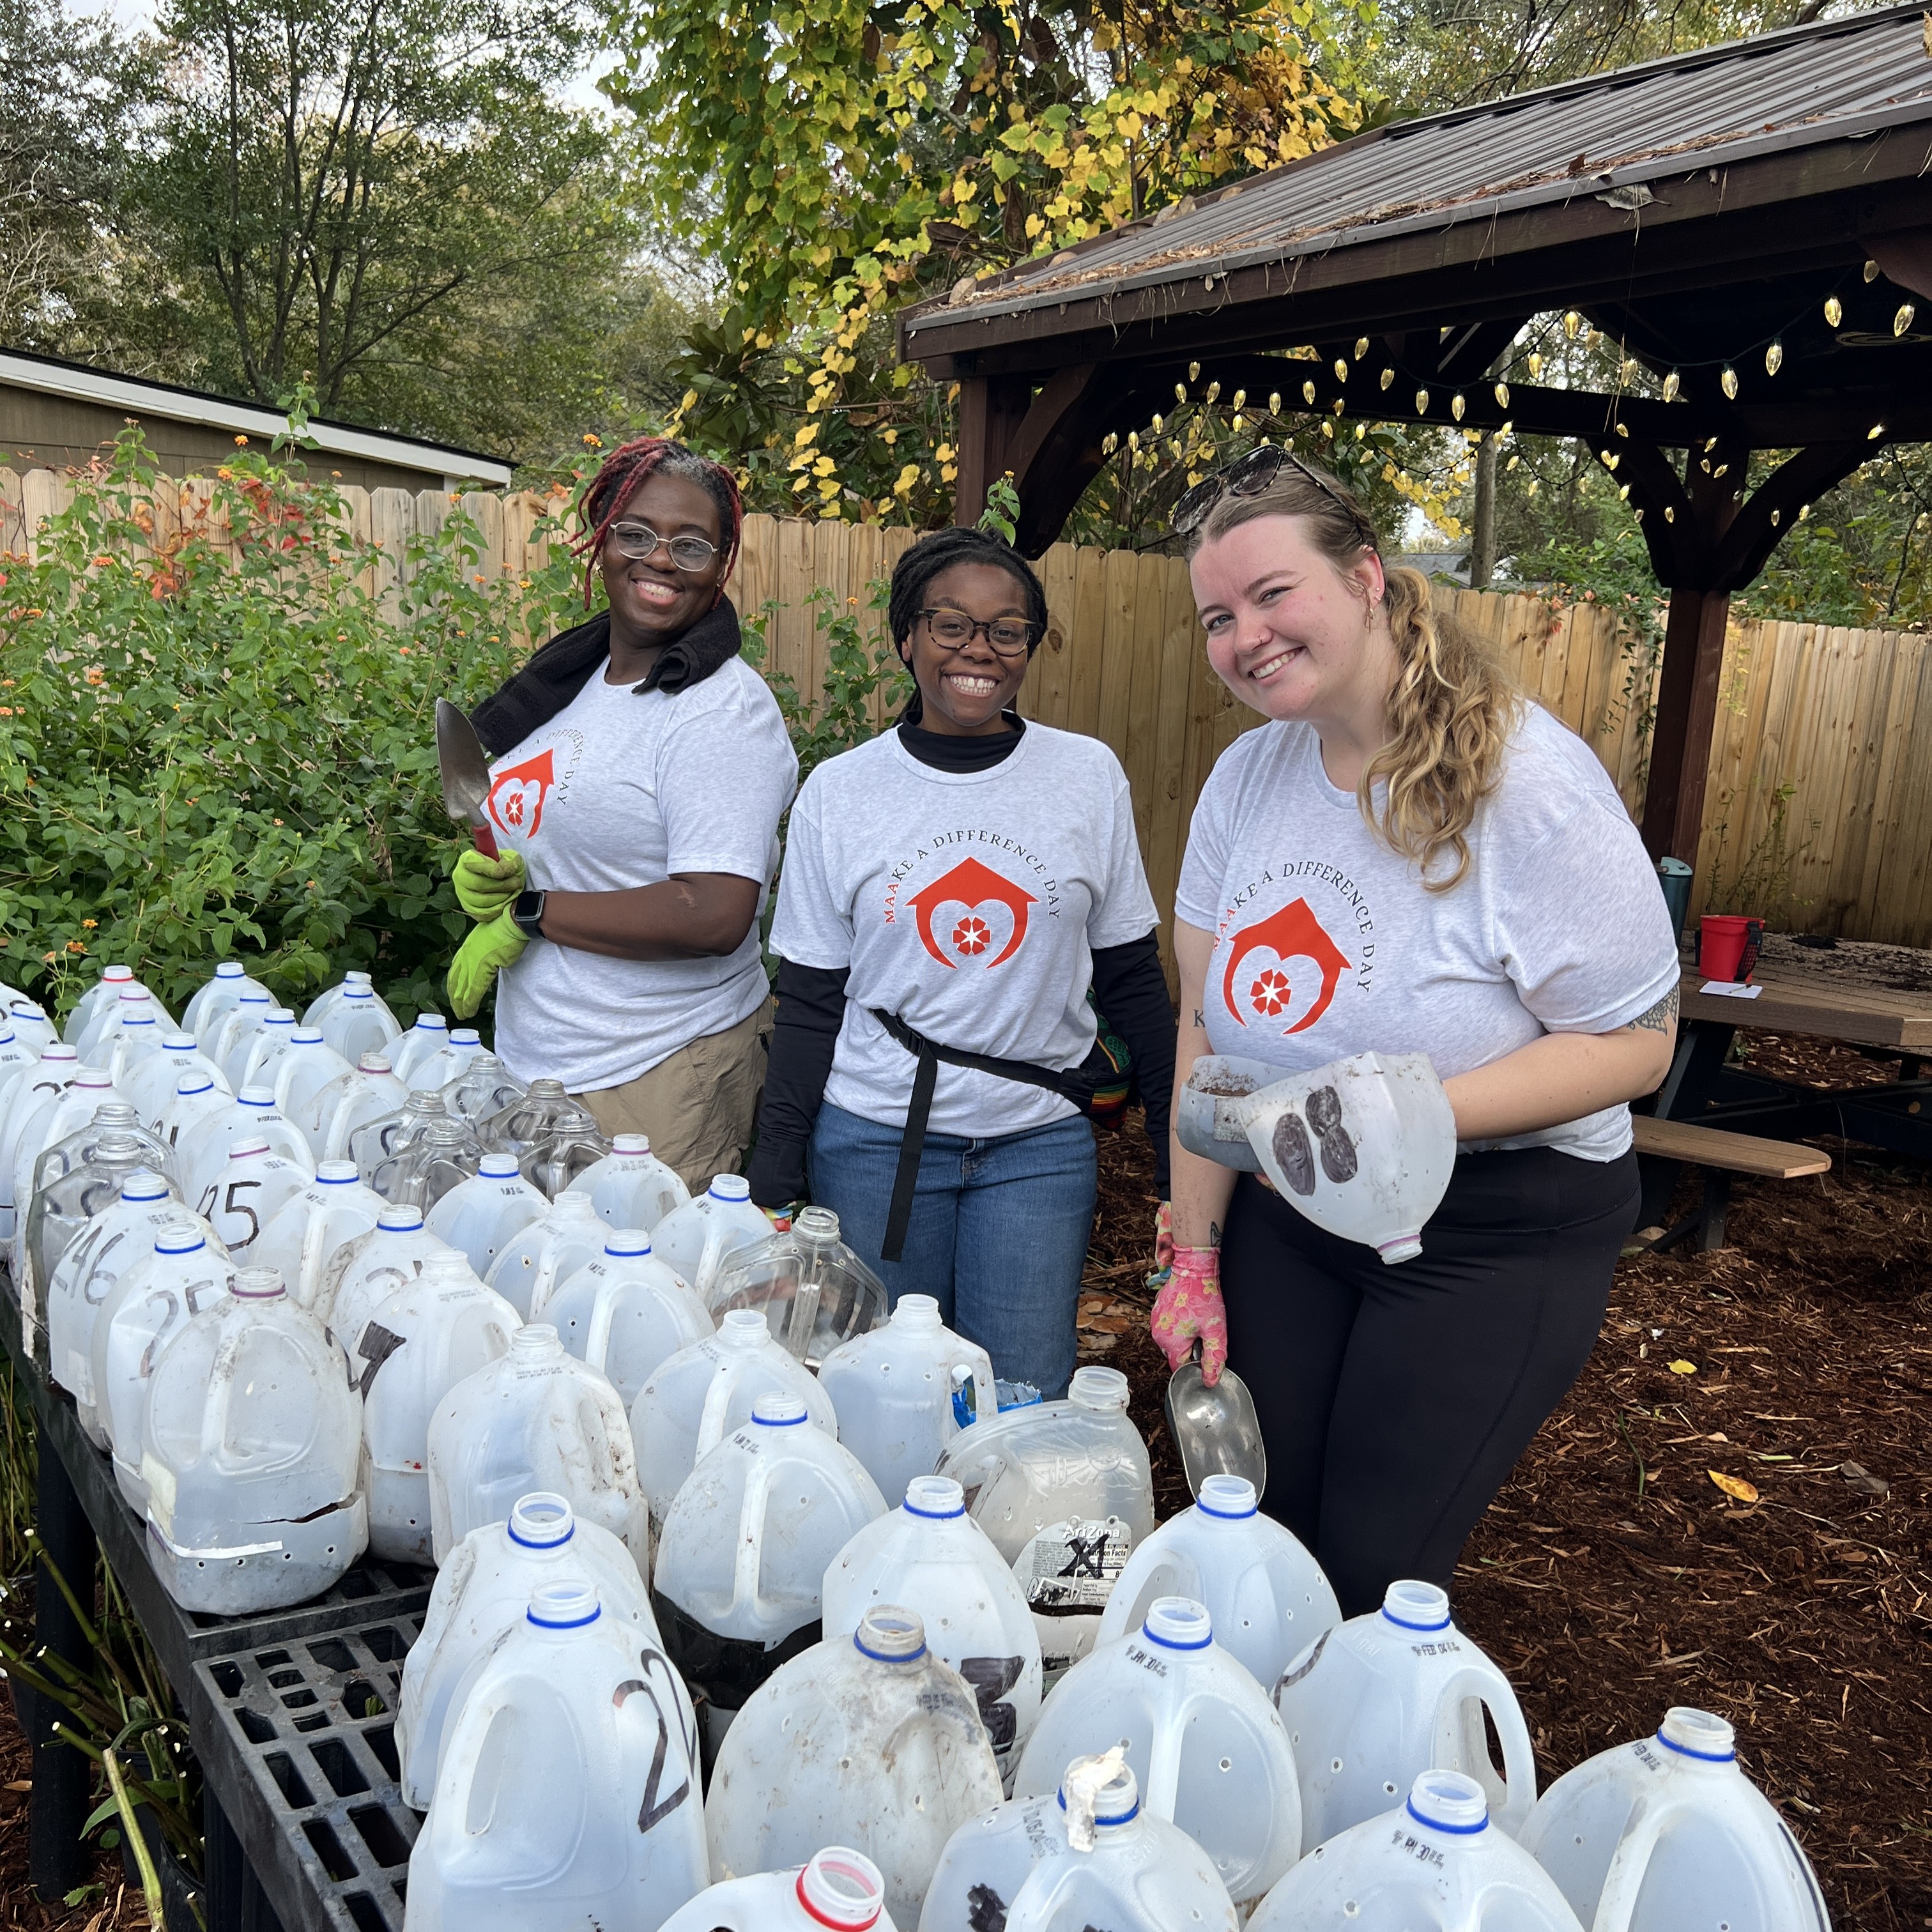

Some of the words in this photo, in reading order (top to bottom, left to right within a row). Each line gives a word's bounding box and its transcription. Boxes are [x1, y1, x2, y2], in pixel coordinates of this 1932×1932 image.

[546, 728, 586, 765] DIFFERENCE
[556, 770, 575, 806] DAY
[883, 859, 914, 924] MAAKE
[916, 848, 929, 860] A
[932, 829, 1047, 875] DIFFERENCE
[1043, 878, 1061, 919] DAY
[1261, 870, 1274, 885] A
[1282, 861, 1374, 935] DIFFERENCE
[1357, 942, 1376, 993] DAY
[1062, 1524, 1121, 1540] AriZona
[1112, 1549, 1126, 1557] Facts
